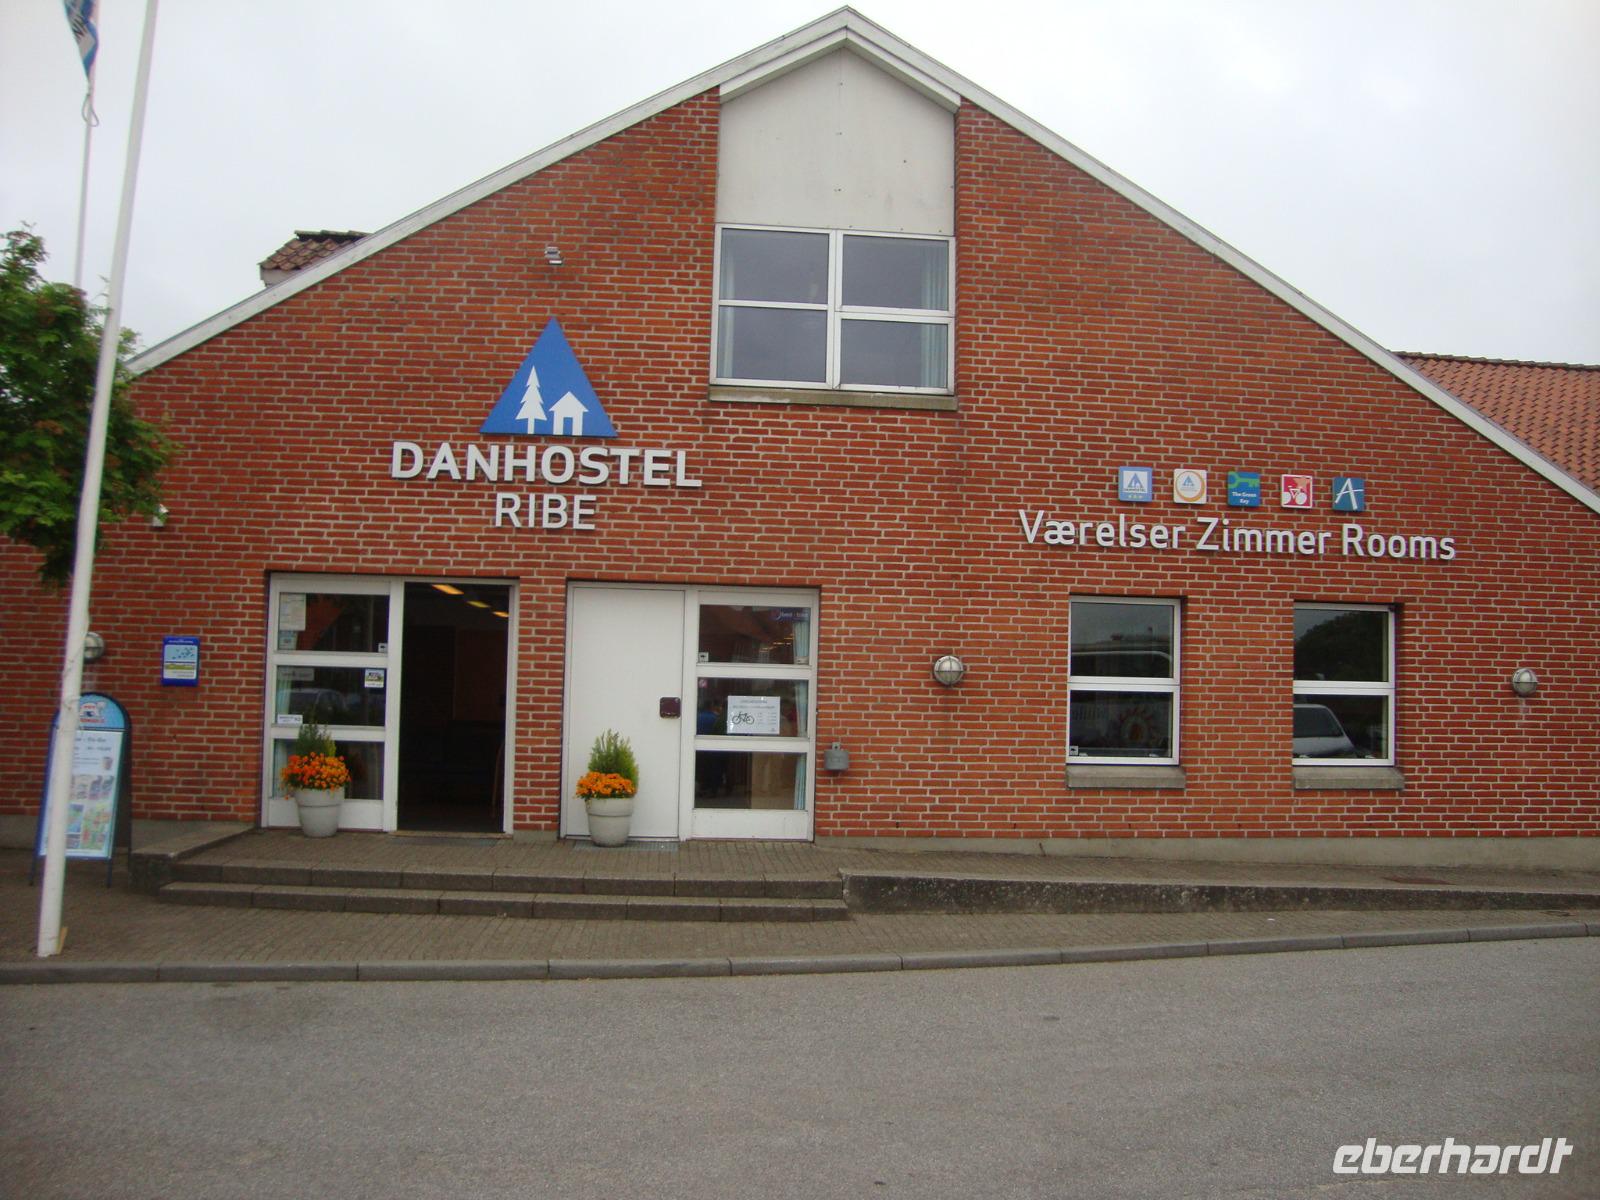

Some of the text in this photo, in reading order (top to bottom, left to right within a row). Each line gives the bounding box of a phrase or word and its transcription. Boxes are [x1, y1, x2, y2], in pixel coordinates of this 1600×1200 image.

[391, 441, 703, 488] DANHOSTEL
[495, 492, 597, 530] RIBE
[1018, 510, 1456, 561] Værelser Zimmer Rooms
